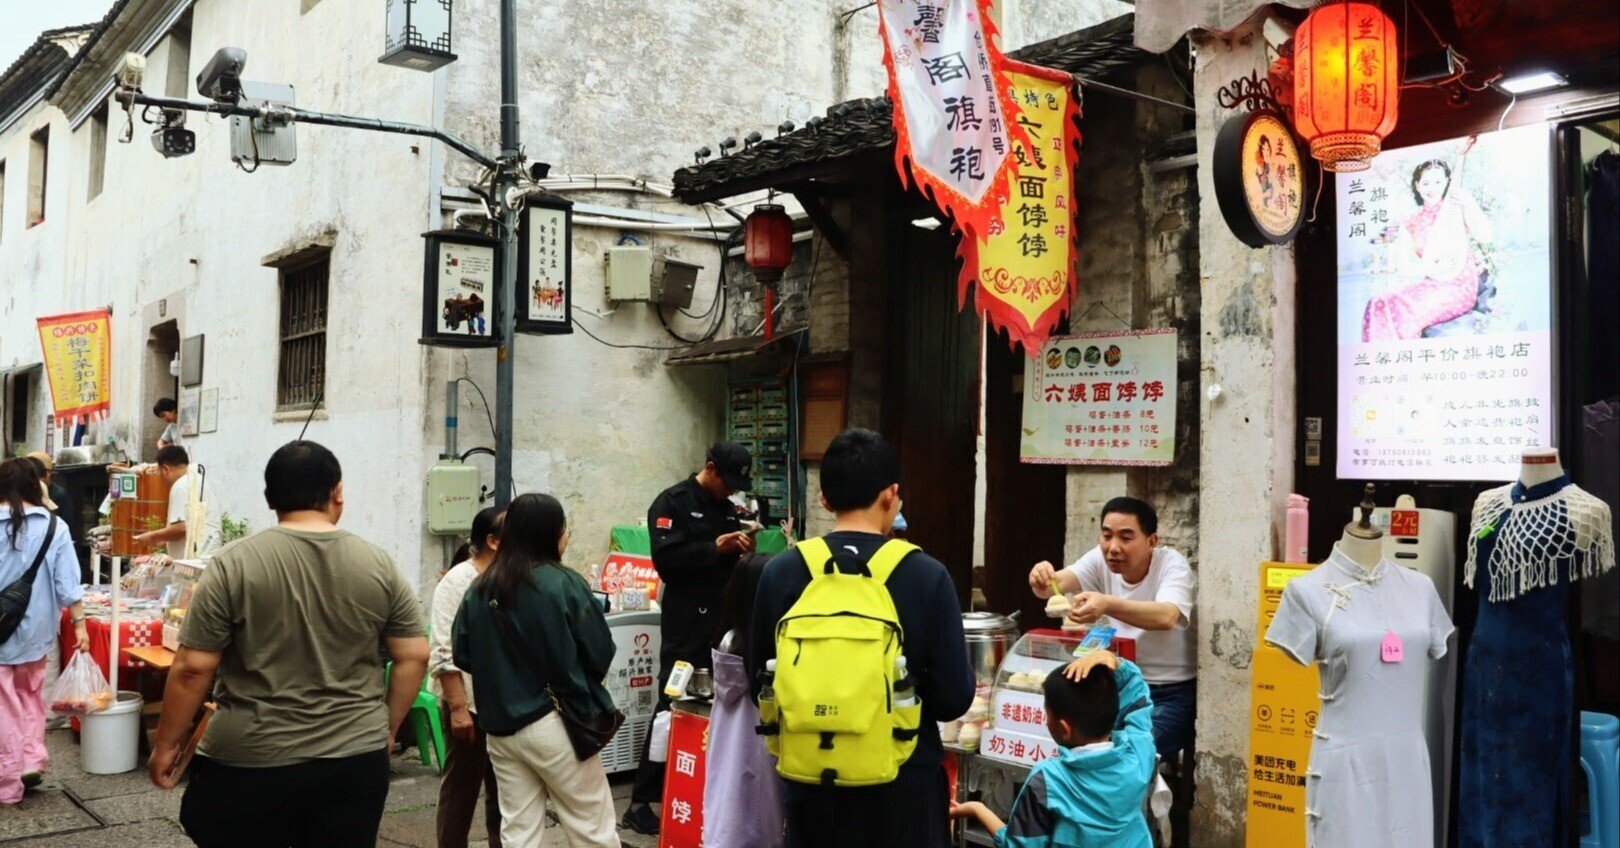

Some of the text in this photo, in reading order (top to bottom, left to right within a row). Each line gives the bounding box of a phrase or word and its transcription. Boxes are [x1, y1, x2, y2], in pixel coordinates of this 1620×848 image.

[1354, 17, 1380, 112] 兰馨阁
[901, 0, 985, 182] 馨阁旗袍
[1013, 116, 1049, 257] 六姨面饽饽
[1274, 137, 1287, 217] 兰馨阁
[1349, 179, 1366, 238] 兰馨阁
[1370, 186, 1390, 224] 旗袍
[1354, 342, 1531, 366] 兰馨阁平价旗袍店
[67, 337, 99, 403] 梅干菜扣肉饼
[1045, 380, 1164, 402] 六姨面饽饽
[1140, 409, 1155, 419] 8元
[1139, 424, 1159, 434] 10元
[1138, 438, 1159, 448] 12元
[1392, 511, 1418, 527] 2元
[1002, 702, 1047, 725] 非遗奶油
[989, 734, 1060, 762] 奶油小
[1254, 754, 1297, 772] 美团充电
[1253, 768, 1307, 788] 给生活加满
[669, 749, 697, 848] 面饽
[1253, 789, 1283, 800] MEITUAN
[1253, 799, 1296, 814] POWER BANK
